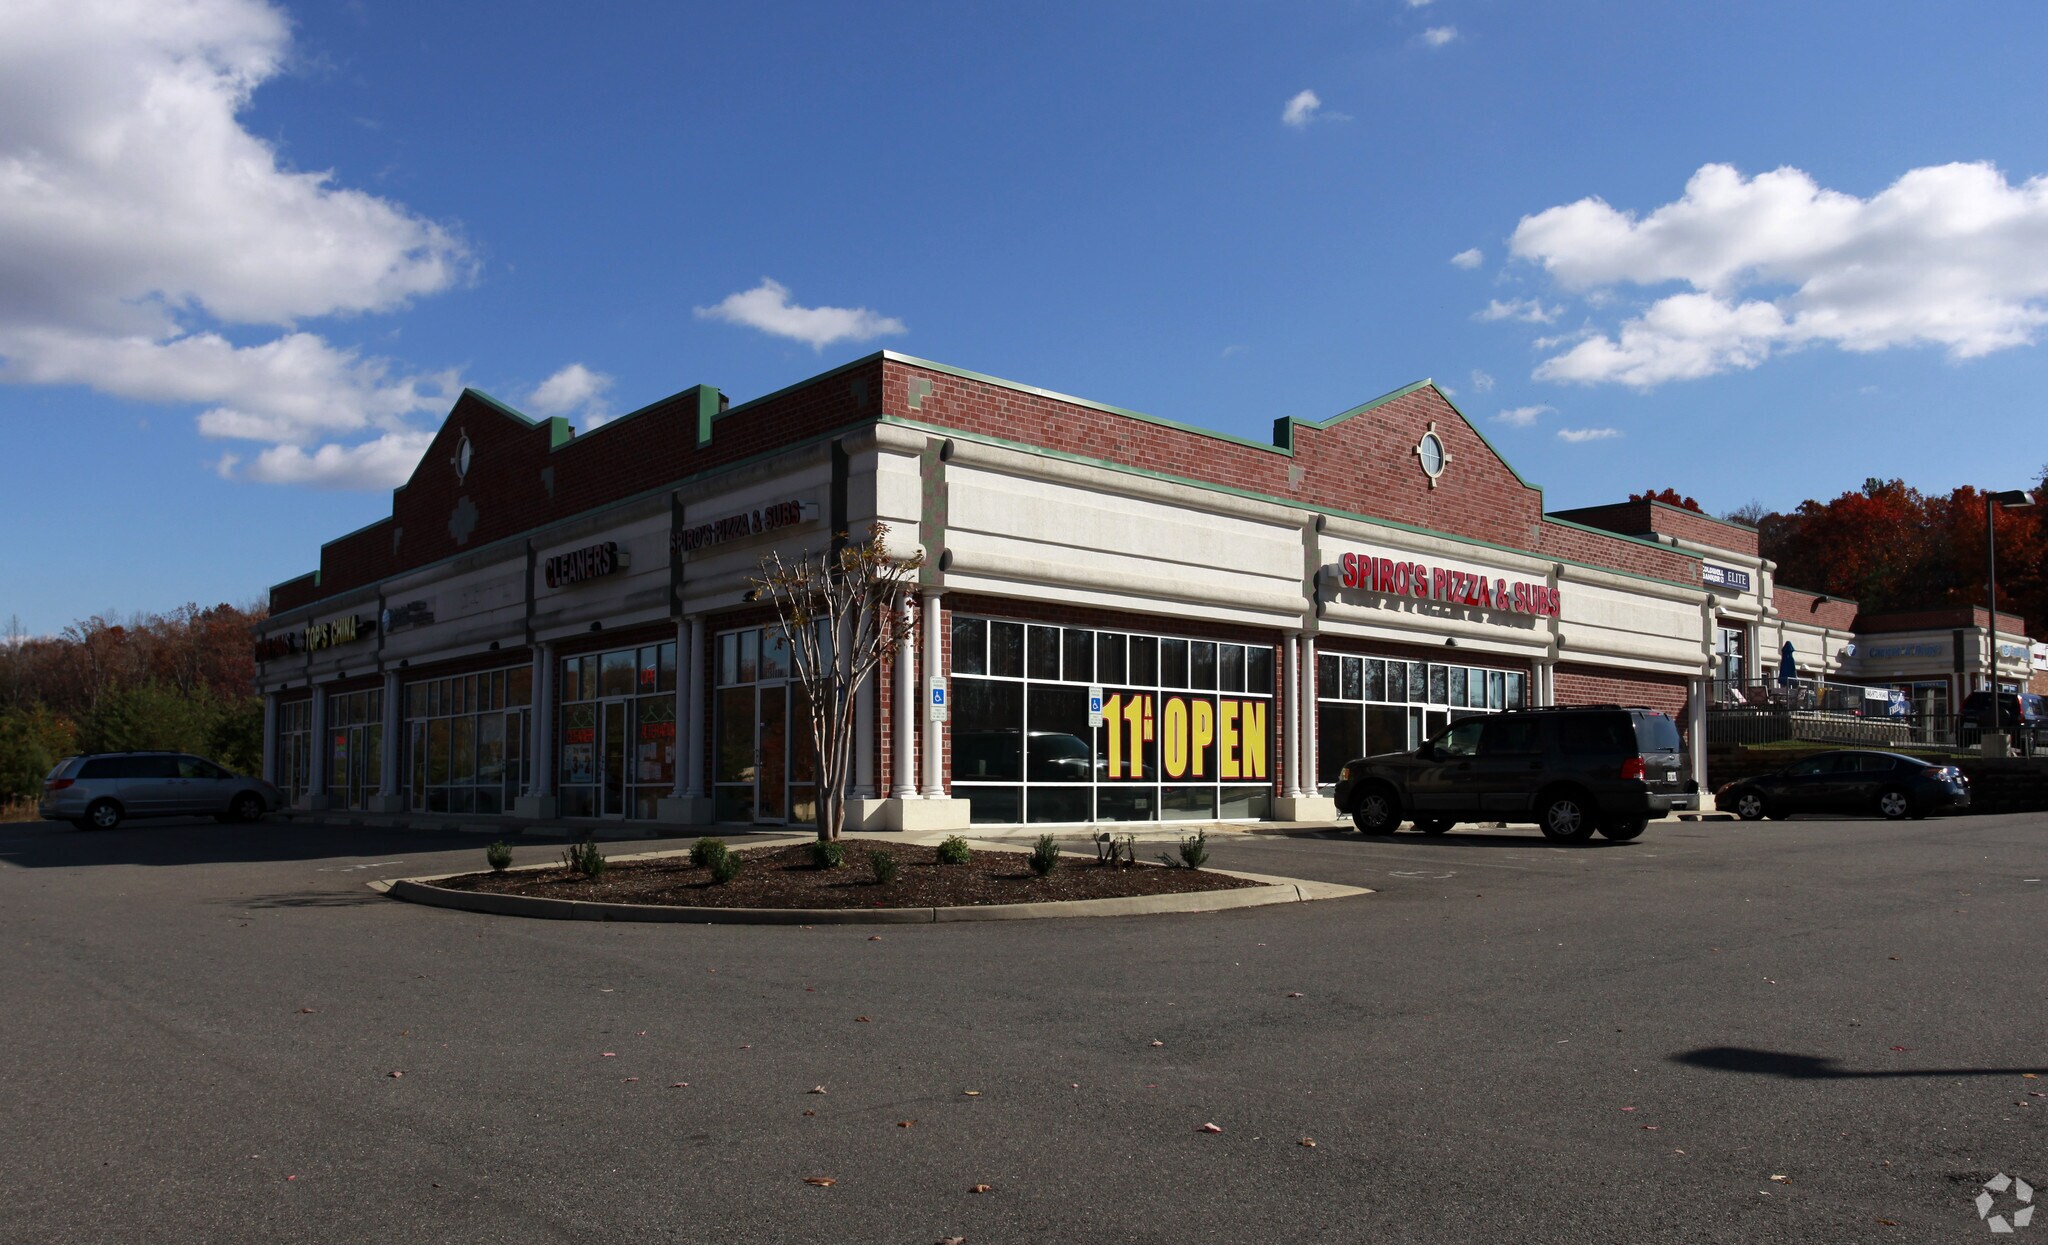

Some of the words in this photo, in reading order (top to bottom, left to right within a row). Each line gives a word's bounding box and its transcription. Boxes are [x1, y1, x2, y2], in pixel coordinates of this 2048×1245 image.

[670, 525, 713, 555] SPIRO'S
[714, 512, 750, 543] PIZZA
[751, 509, 762, 533] &
[764, 500, 801, 530] SUBS
[545, 541, 615, 588] CLEANERS
[1342, 552, 1428, 599] SPIRO'S
[1432, 567, 1491, 608] PIZZA
[1495, 578, 1510, 611] &
[1513, 581, 1561, 618] SUBS
[1727, 571, 1746, 585] ELITE
[331, 615, 357, 646] CHINA
[1163, 695, 1267, 779] OPEN
